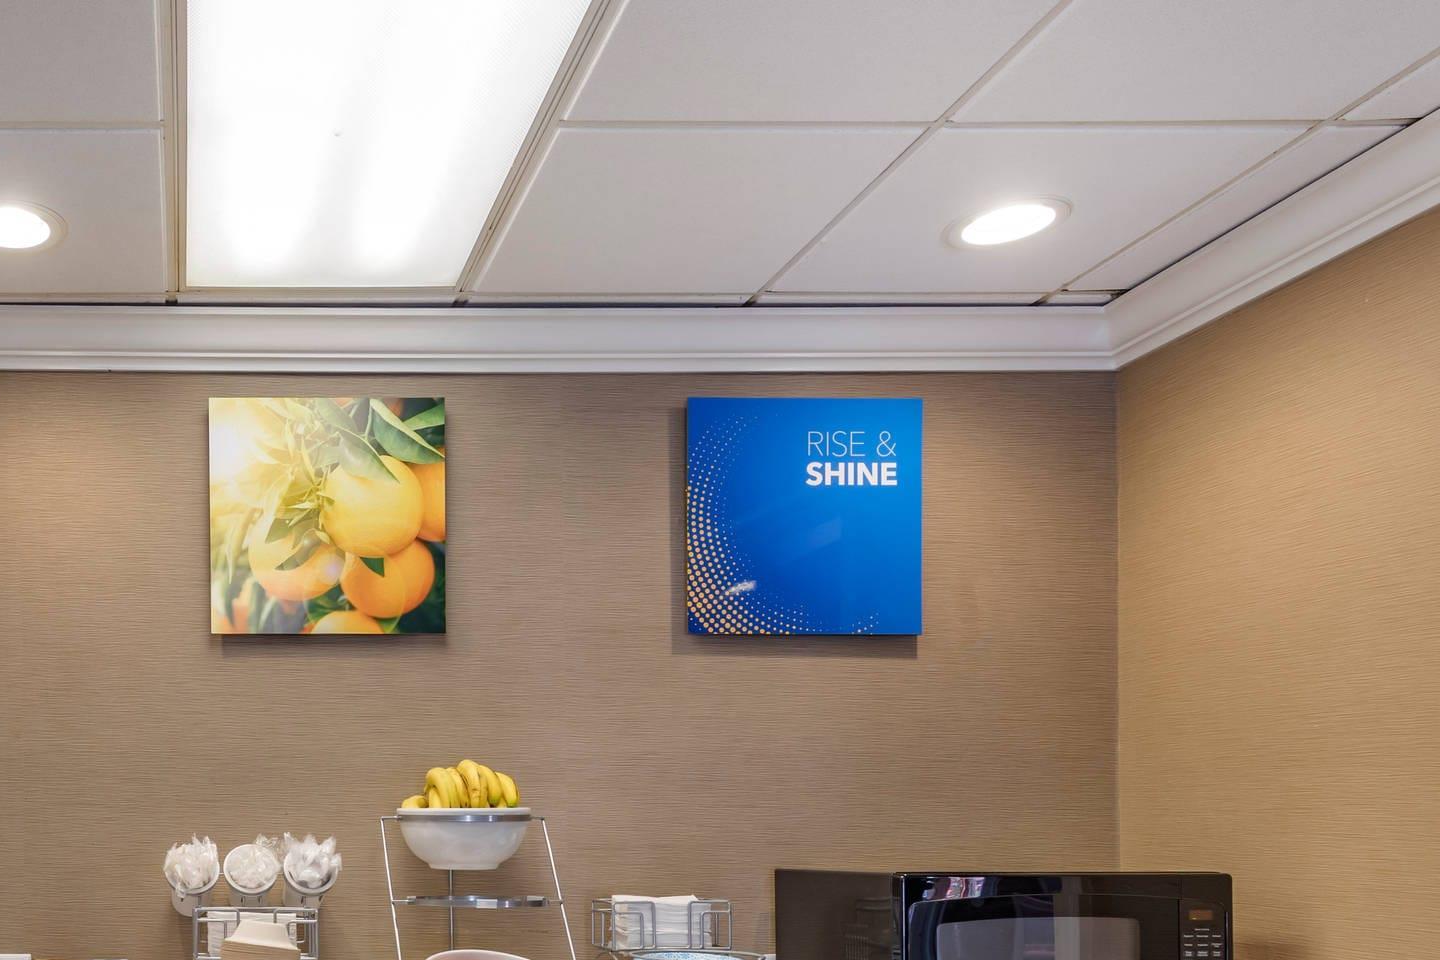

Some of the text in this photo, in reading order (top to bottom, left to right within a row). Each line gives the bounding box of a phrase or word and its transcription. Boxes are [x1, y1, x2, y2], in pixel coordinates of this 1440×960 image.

[807, 430, 897, 457] RISE &
[805, 461, 898, 486] SHINE
